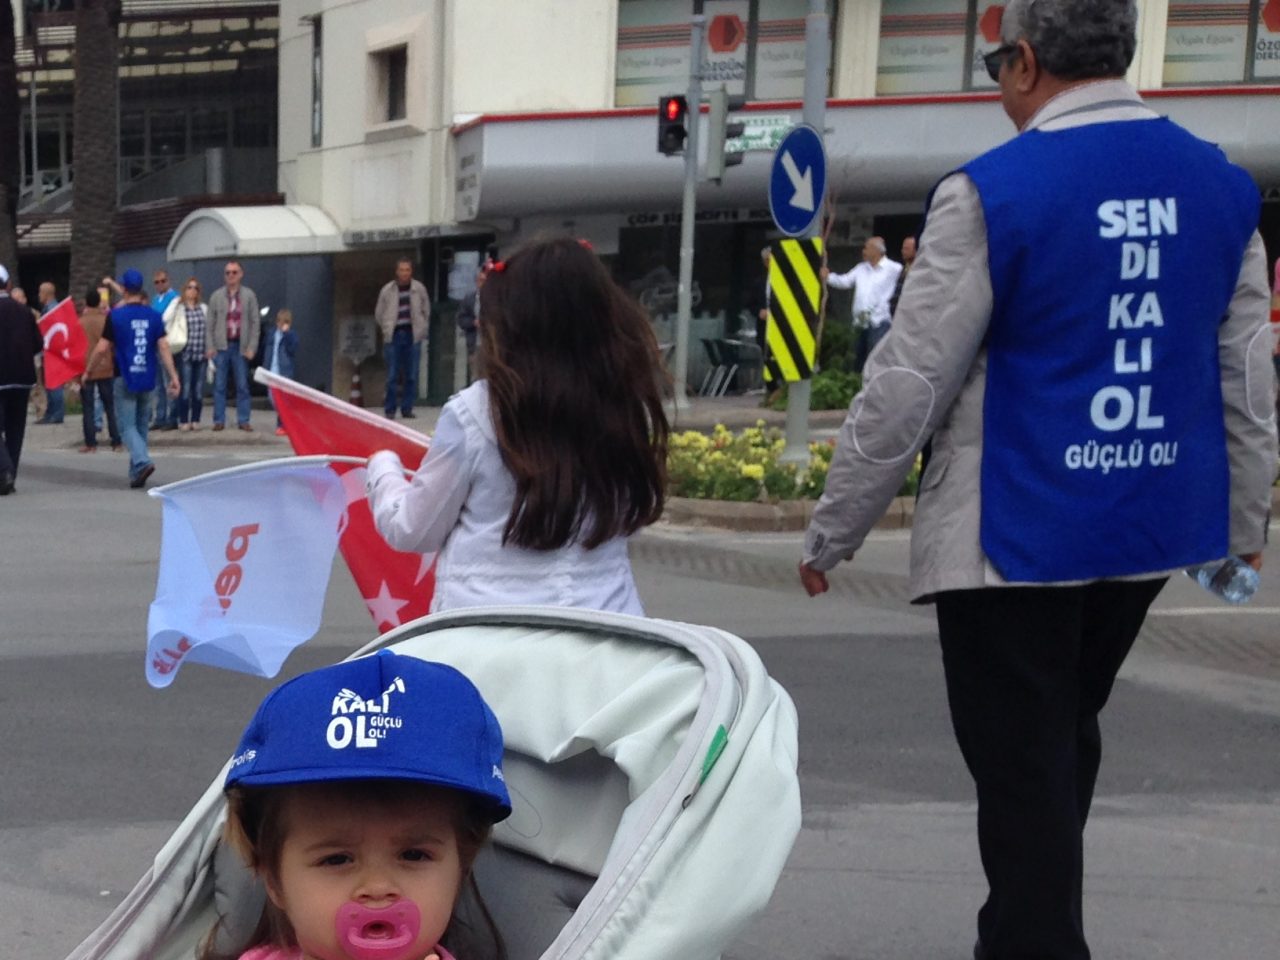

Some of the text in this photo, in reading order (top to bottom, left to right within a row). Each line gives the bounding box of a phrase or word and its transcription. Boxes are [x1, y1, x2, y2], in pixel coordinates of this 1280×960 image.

[1256, 38, 1280, 51] ÖZG
[1097, 197, 1178, 238] SEN
[1120, 240, 1160, 280] Dİ
[1107, 291, 1165, 330] KA
[1114, 337, 1152, 374] LI
[1089, 385, 1165, 432] OL
[1064, 439, 1178, 475] GÜÇLÜ OL!
[326, 714, 378, 750] OL
[368, 728, 387, 739] OL!
[370, 713, 403, 729] GÜÇLÜ
